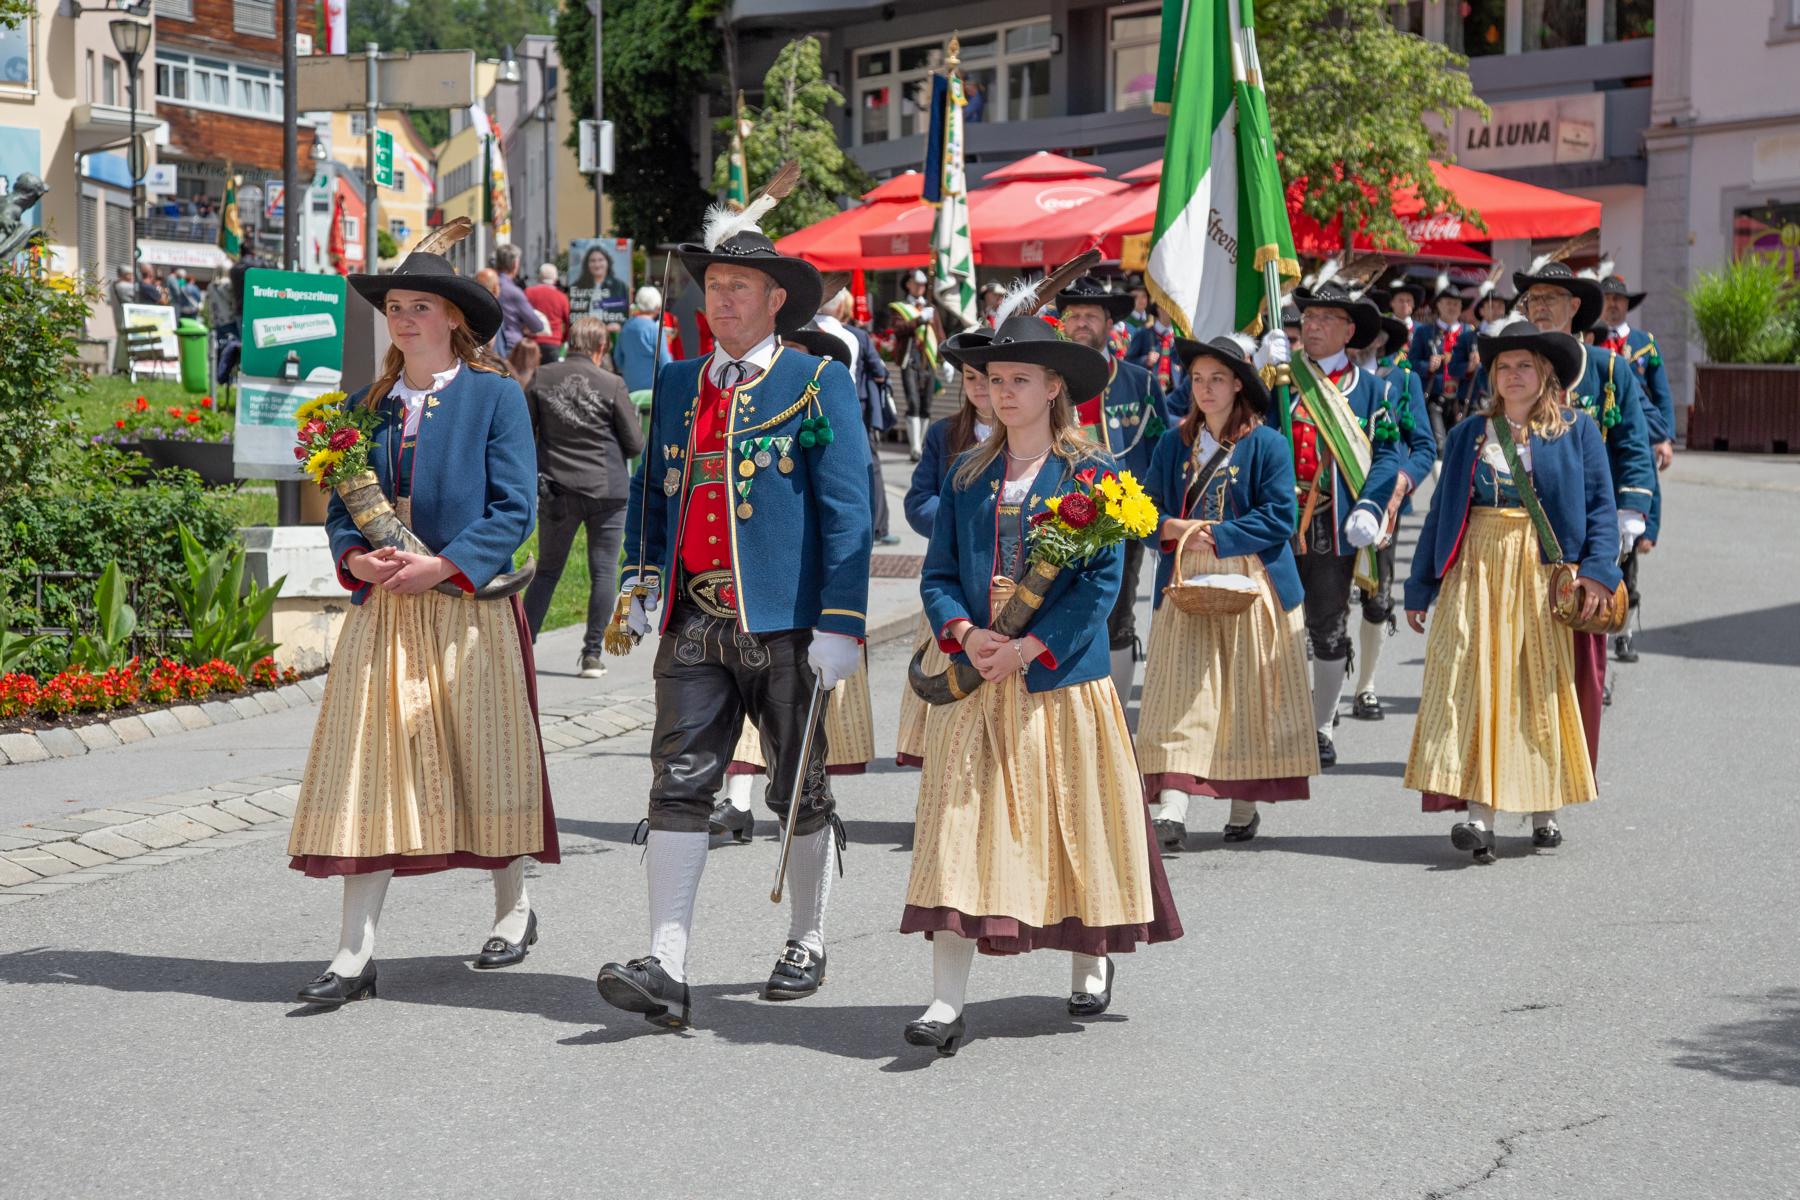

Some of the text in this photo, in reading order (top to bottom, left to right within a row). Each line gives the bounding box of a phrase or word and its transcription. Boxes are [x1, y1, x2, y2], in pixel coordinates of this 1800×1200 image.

[1467, 127, 1490, 149] LA
[1495, 120, 1550, 147] LUNA
[252, 285, 339, 304] Tiroler Tageszeitung
